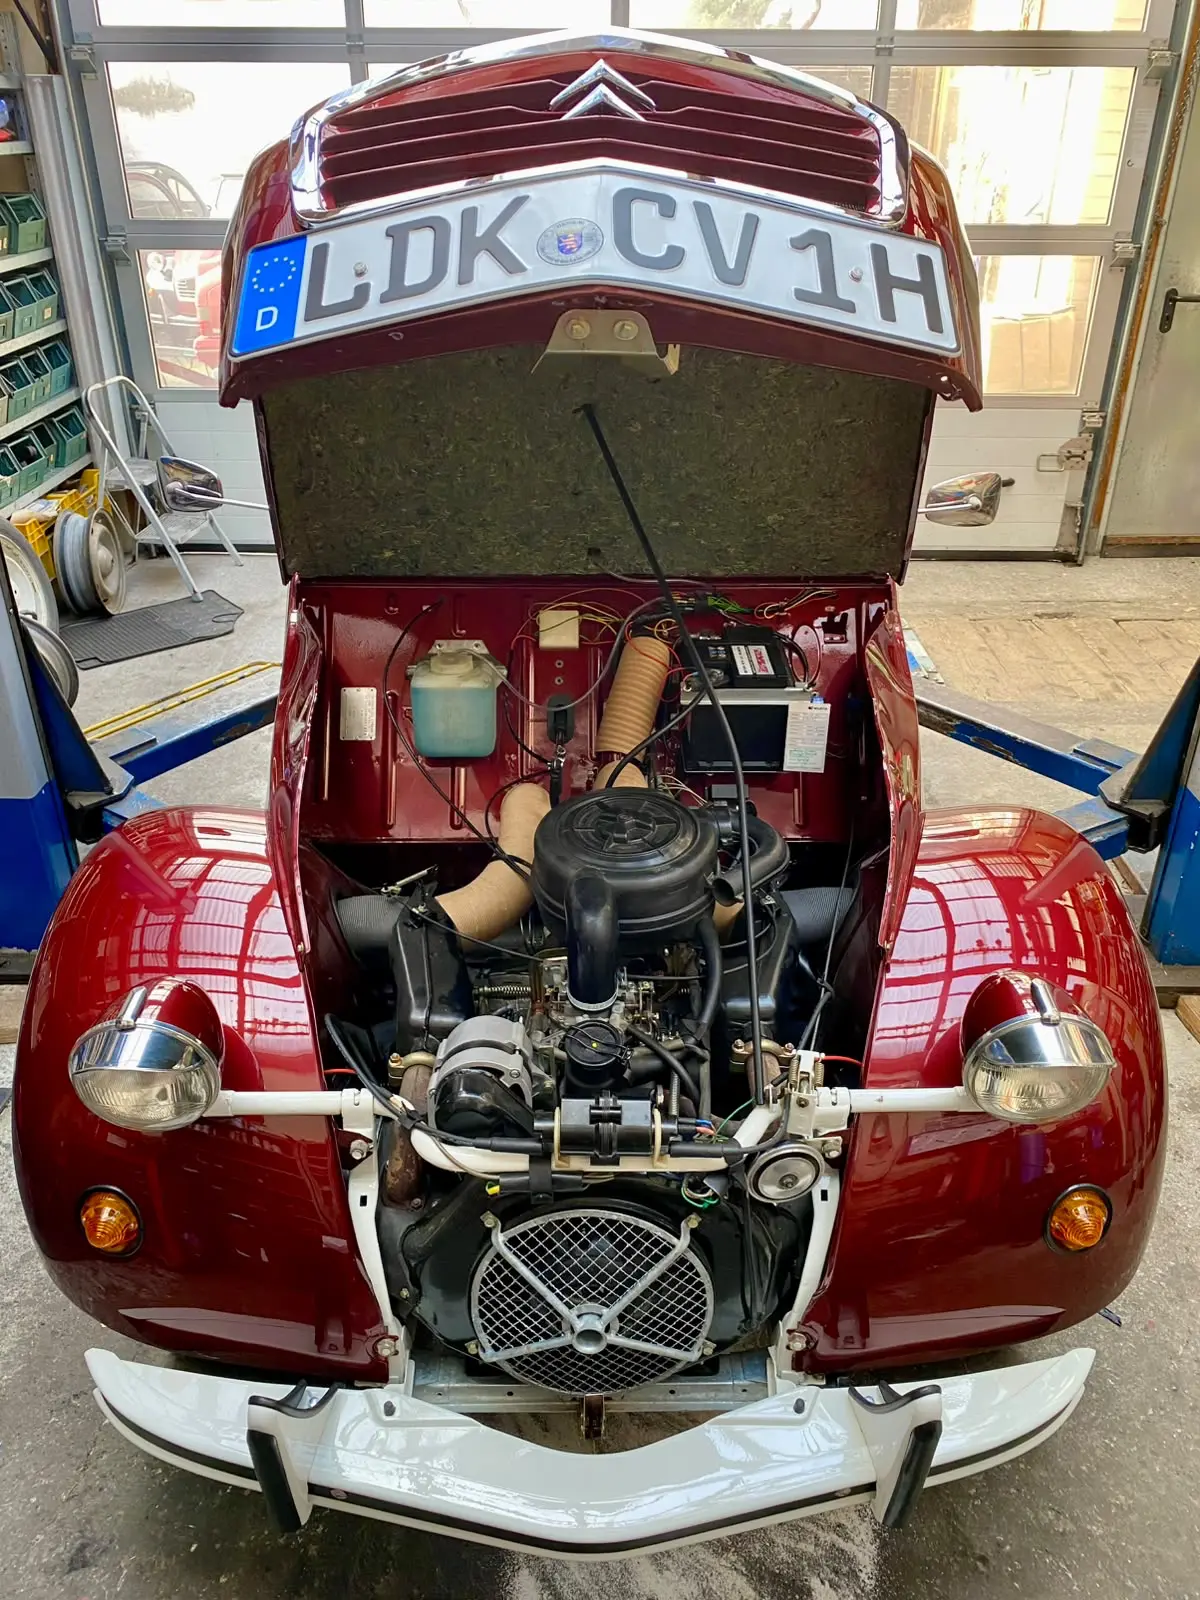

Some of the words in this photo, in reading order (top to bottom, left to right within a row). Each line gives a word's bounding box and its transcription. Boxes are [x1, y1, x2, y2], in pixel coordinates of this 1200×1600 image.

[304, 195, 531, 322] LDK
[612, 187, 759, 286] CV
[790, 228, 944, 334] 1H
[255, 306, 278, 332] D
